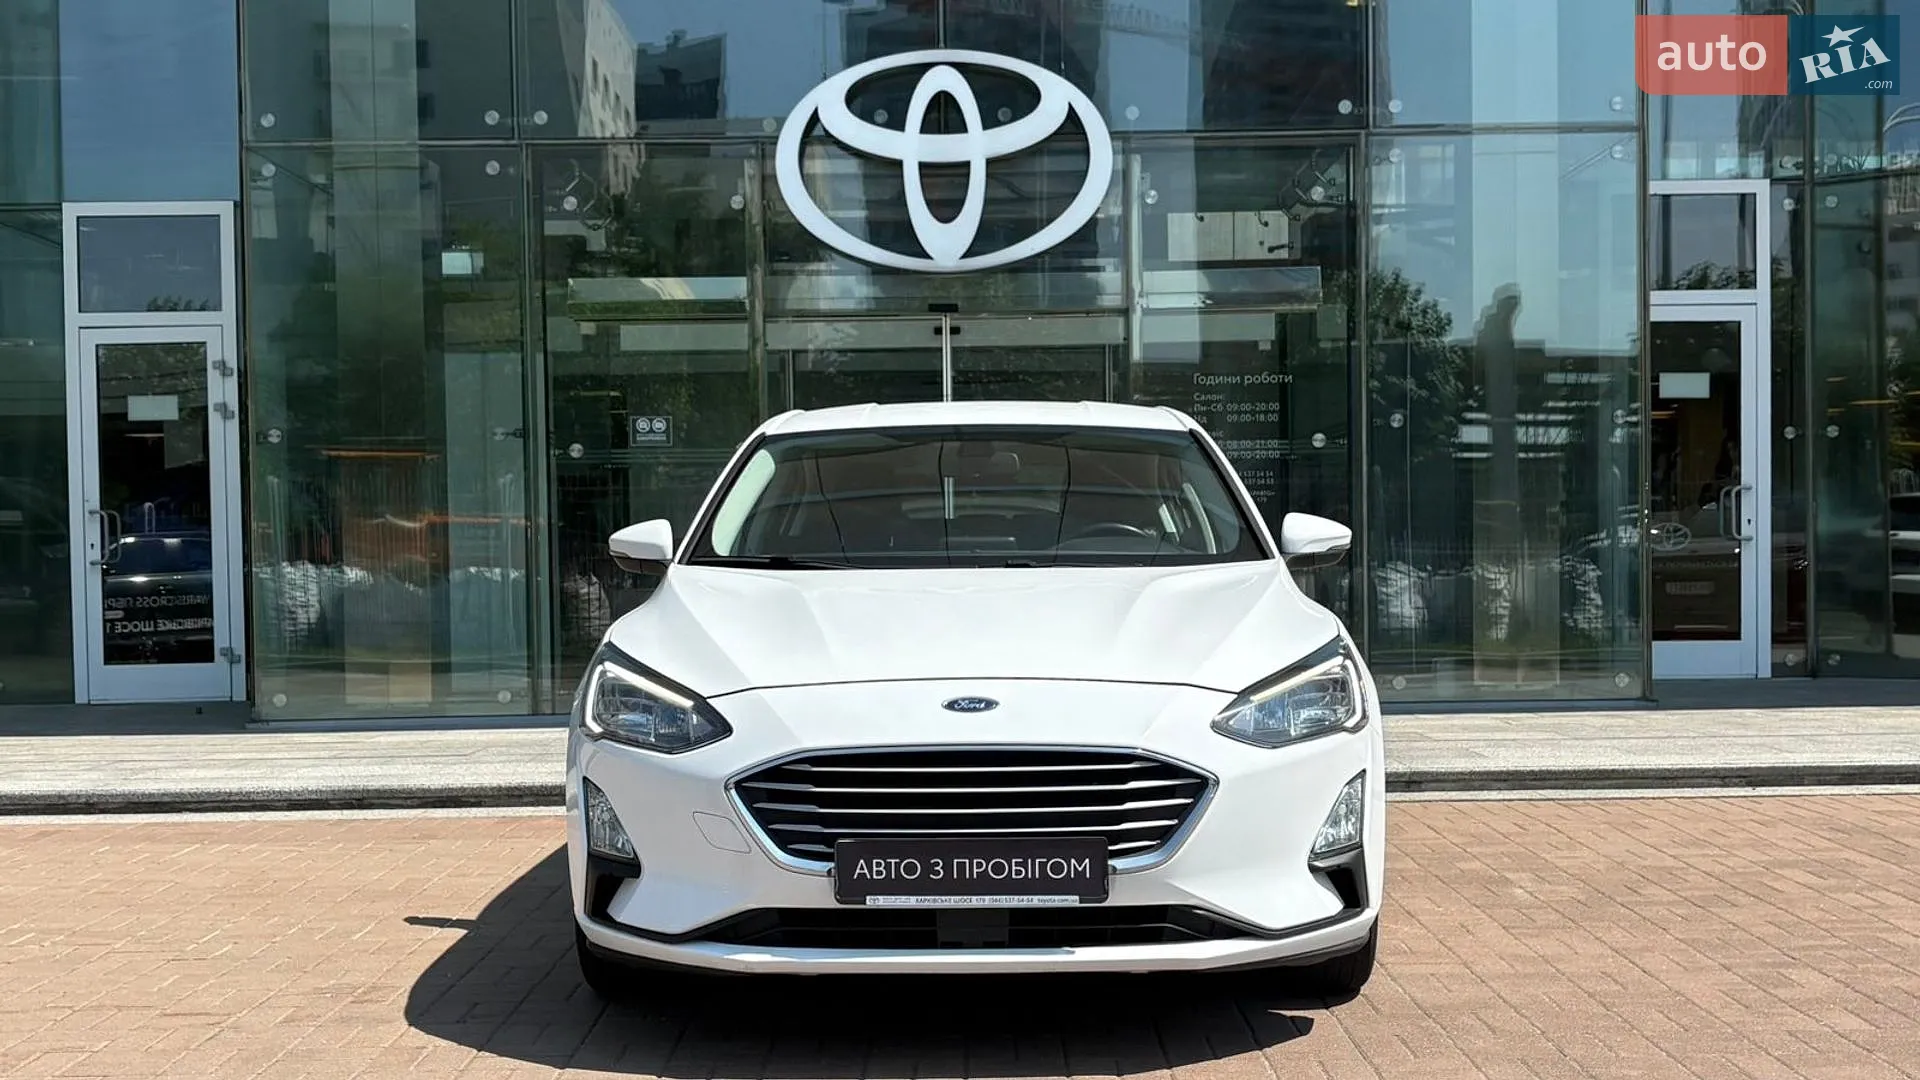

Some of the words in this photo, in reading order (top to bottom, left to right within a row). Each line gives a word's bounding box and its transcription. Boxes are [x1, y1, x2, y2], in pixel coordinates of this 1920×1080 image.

[1193, 373, 1240, 386] Години
[1244, 371, 1293, 387] роботи
[1194, 403, 1223, 412] Пн-Сб
[853, 858, 921, 880] АВТО
[929, 858, 944, 880] З
[953, 857, 1091, 879] ПРОБІГОМ
